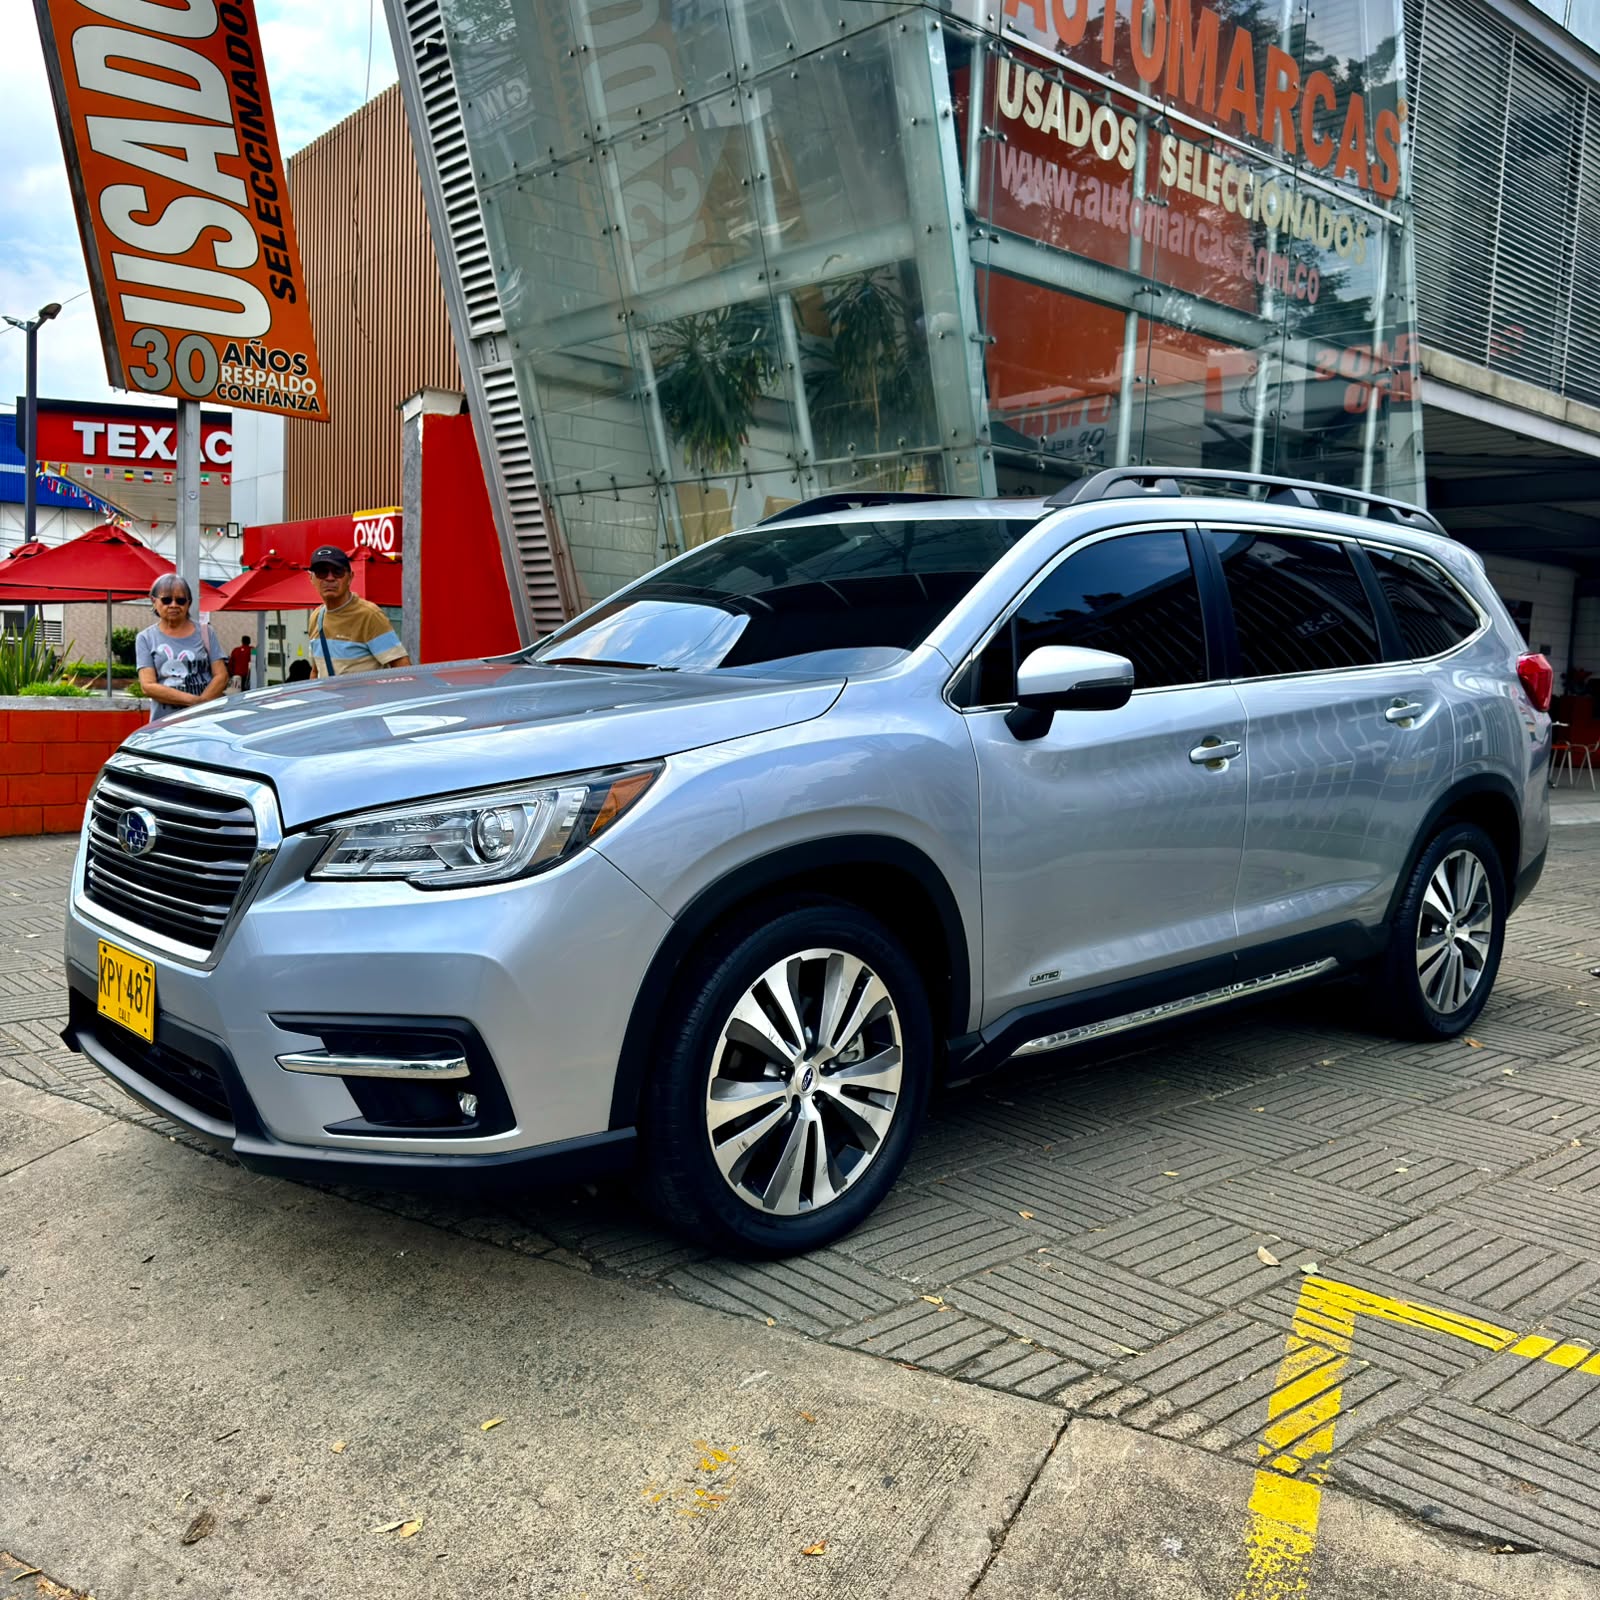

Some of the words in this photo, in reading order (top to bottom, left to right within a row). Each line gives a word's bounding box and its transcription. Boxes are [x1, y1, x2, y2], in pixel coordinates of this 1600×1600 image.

[1004, 0, 1400, 200] OMARCAS
[219, 0, 297, 304] SELECCINADO
[999, 56, 1137, 171] USADOS
[1160, 134, 1368, 265] SELECCIONADOS
[1001, 146, 1320, 305] www.automarcas.com.co
[129, 326, 219, 398] 30
[221, 340, 308, 377] AÑOS
[221, 365, 317, 396] RESPALDO
[216, 383, 321, 413] CONFIANZA
[73, 421, 232, 464] TEXC
[354, 516, 395, 551] OXXO
[100, 954, 123, 1003] KPY
[127, 968, 151, 1018] 487
